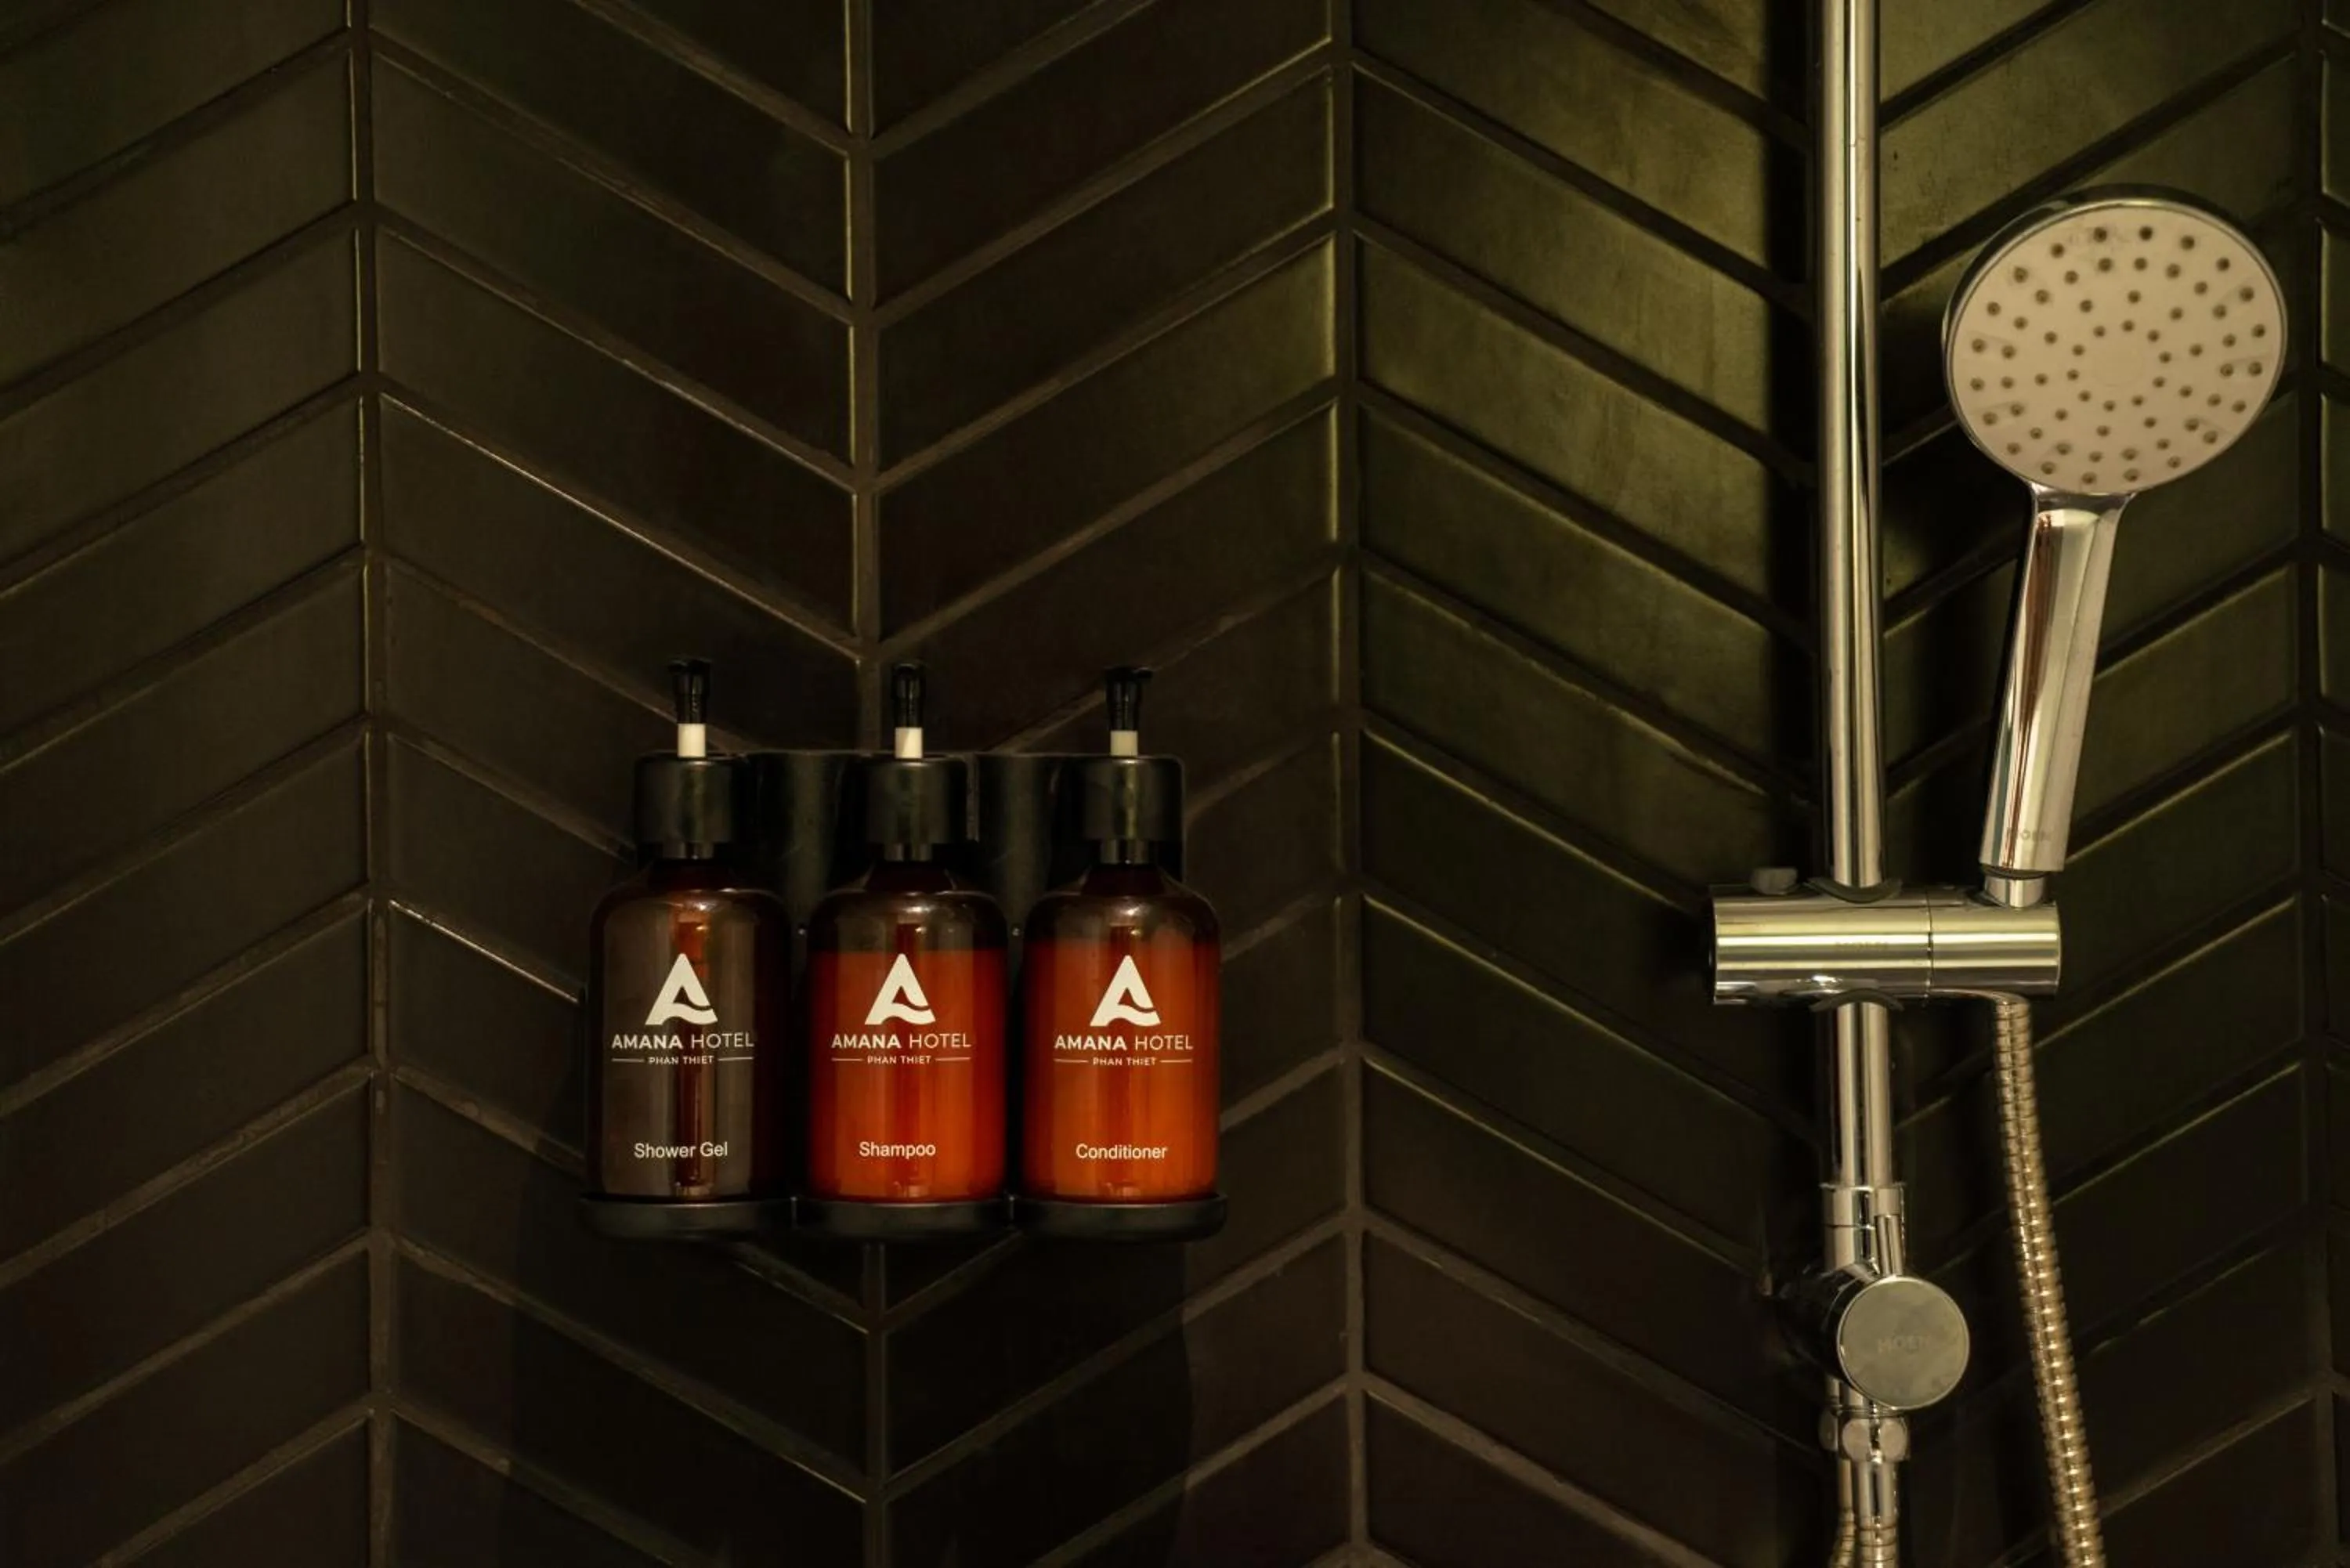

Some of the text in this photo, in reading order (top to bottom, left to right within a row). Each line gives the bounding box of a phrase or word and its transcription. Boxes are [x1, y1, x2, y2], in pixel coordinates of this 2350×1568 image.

[612, 1031, 754, 1050] AMANA HOTEL
[831, 1032, 971, 1050] AMANA HOTEL
[1054, 1035, 1193, 1051] AMANA HOTEL
[648, 1054, 714, 1065] PHAN THIET
[867, 1055, 931, 1064] PHAN THIET
[1092, 1057, 1157, 1066] PHAN THIET
[634, 1141, 728, 1159] Shower Gel
[859, 1141, 936, 1160] Shampoo
[1076, 1143, 1168, 1160] Conditioner
